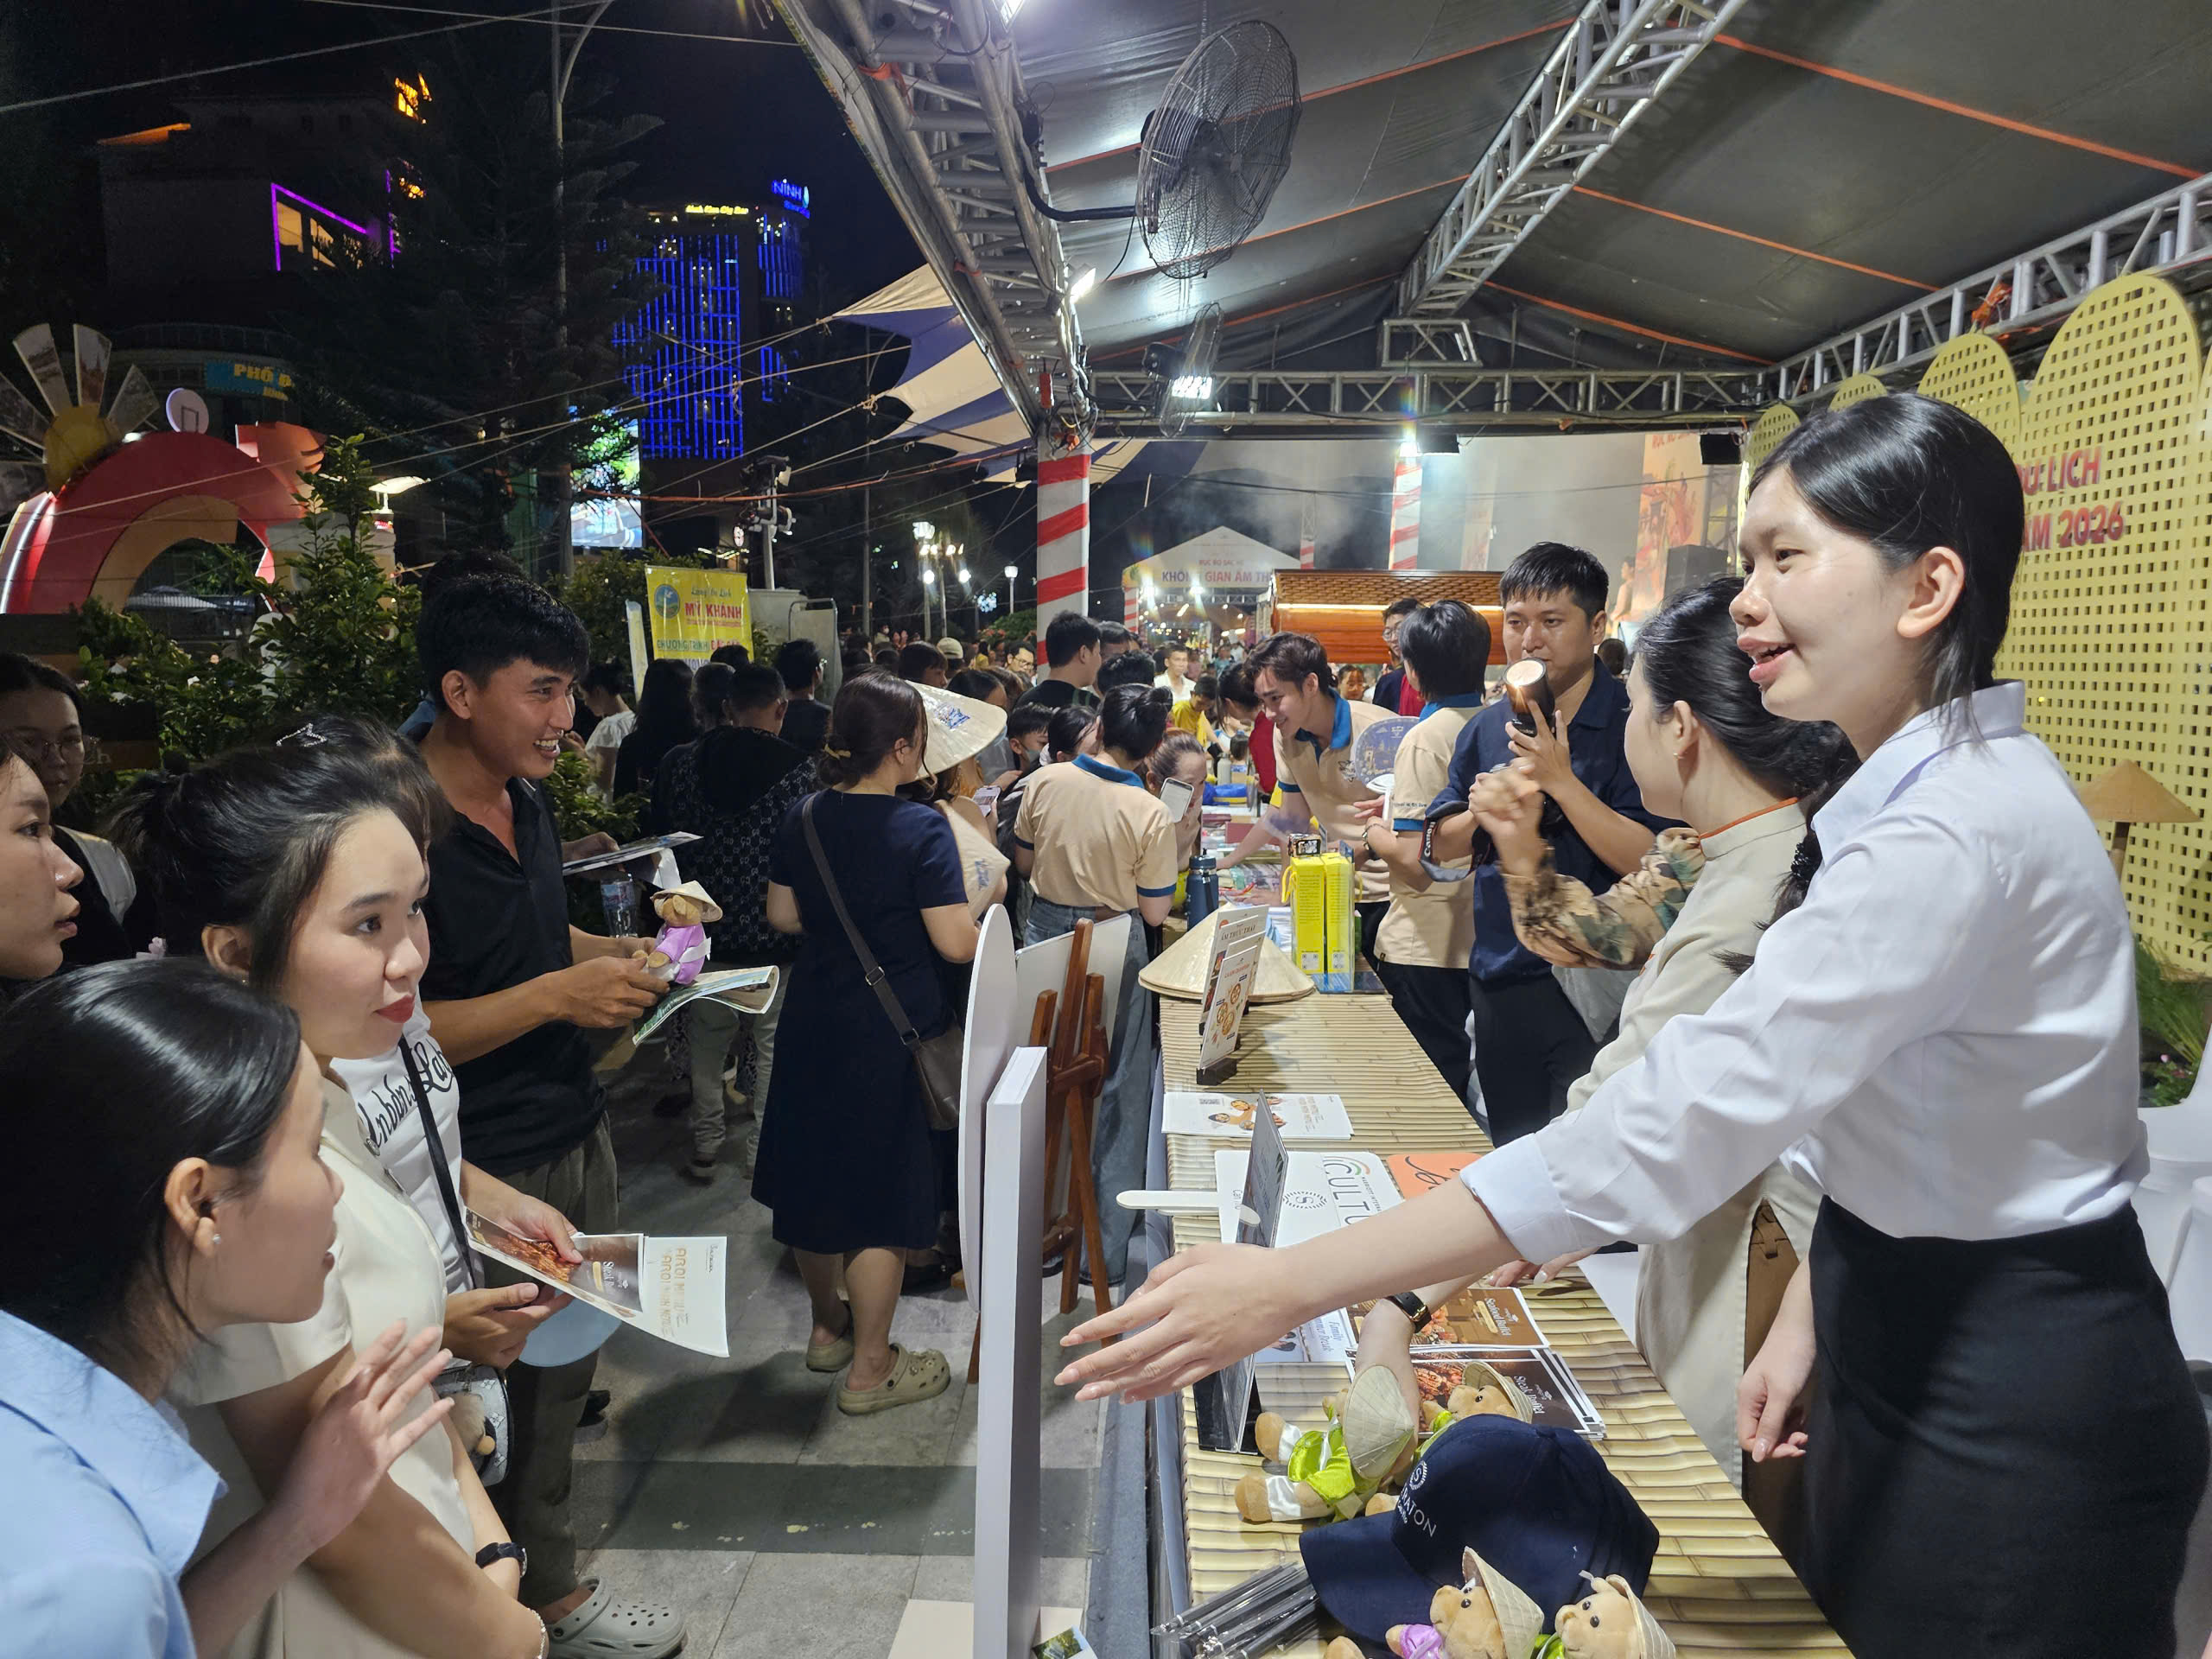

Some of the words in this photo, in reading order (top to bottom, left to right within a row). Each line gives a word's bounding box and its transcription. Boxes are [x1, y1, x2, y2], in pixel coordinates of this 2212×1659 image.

[2046, 448, 2102, 494] LỊCH
[2059, 500, 2124, 549] 2026
[706, 602, 741, 619] KHÁNH
[1424, 822, 1436, 857] Canon
[1514, 1376, 1533, 1394] Steak
